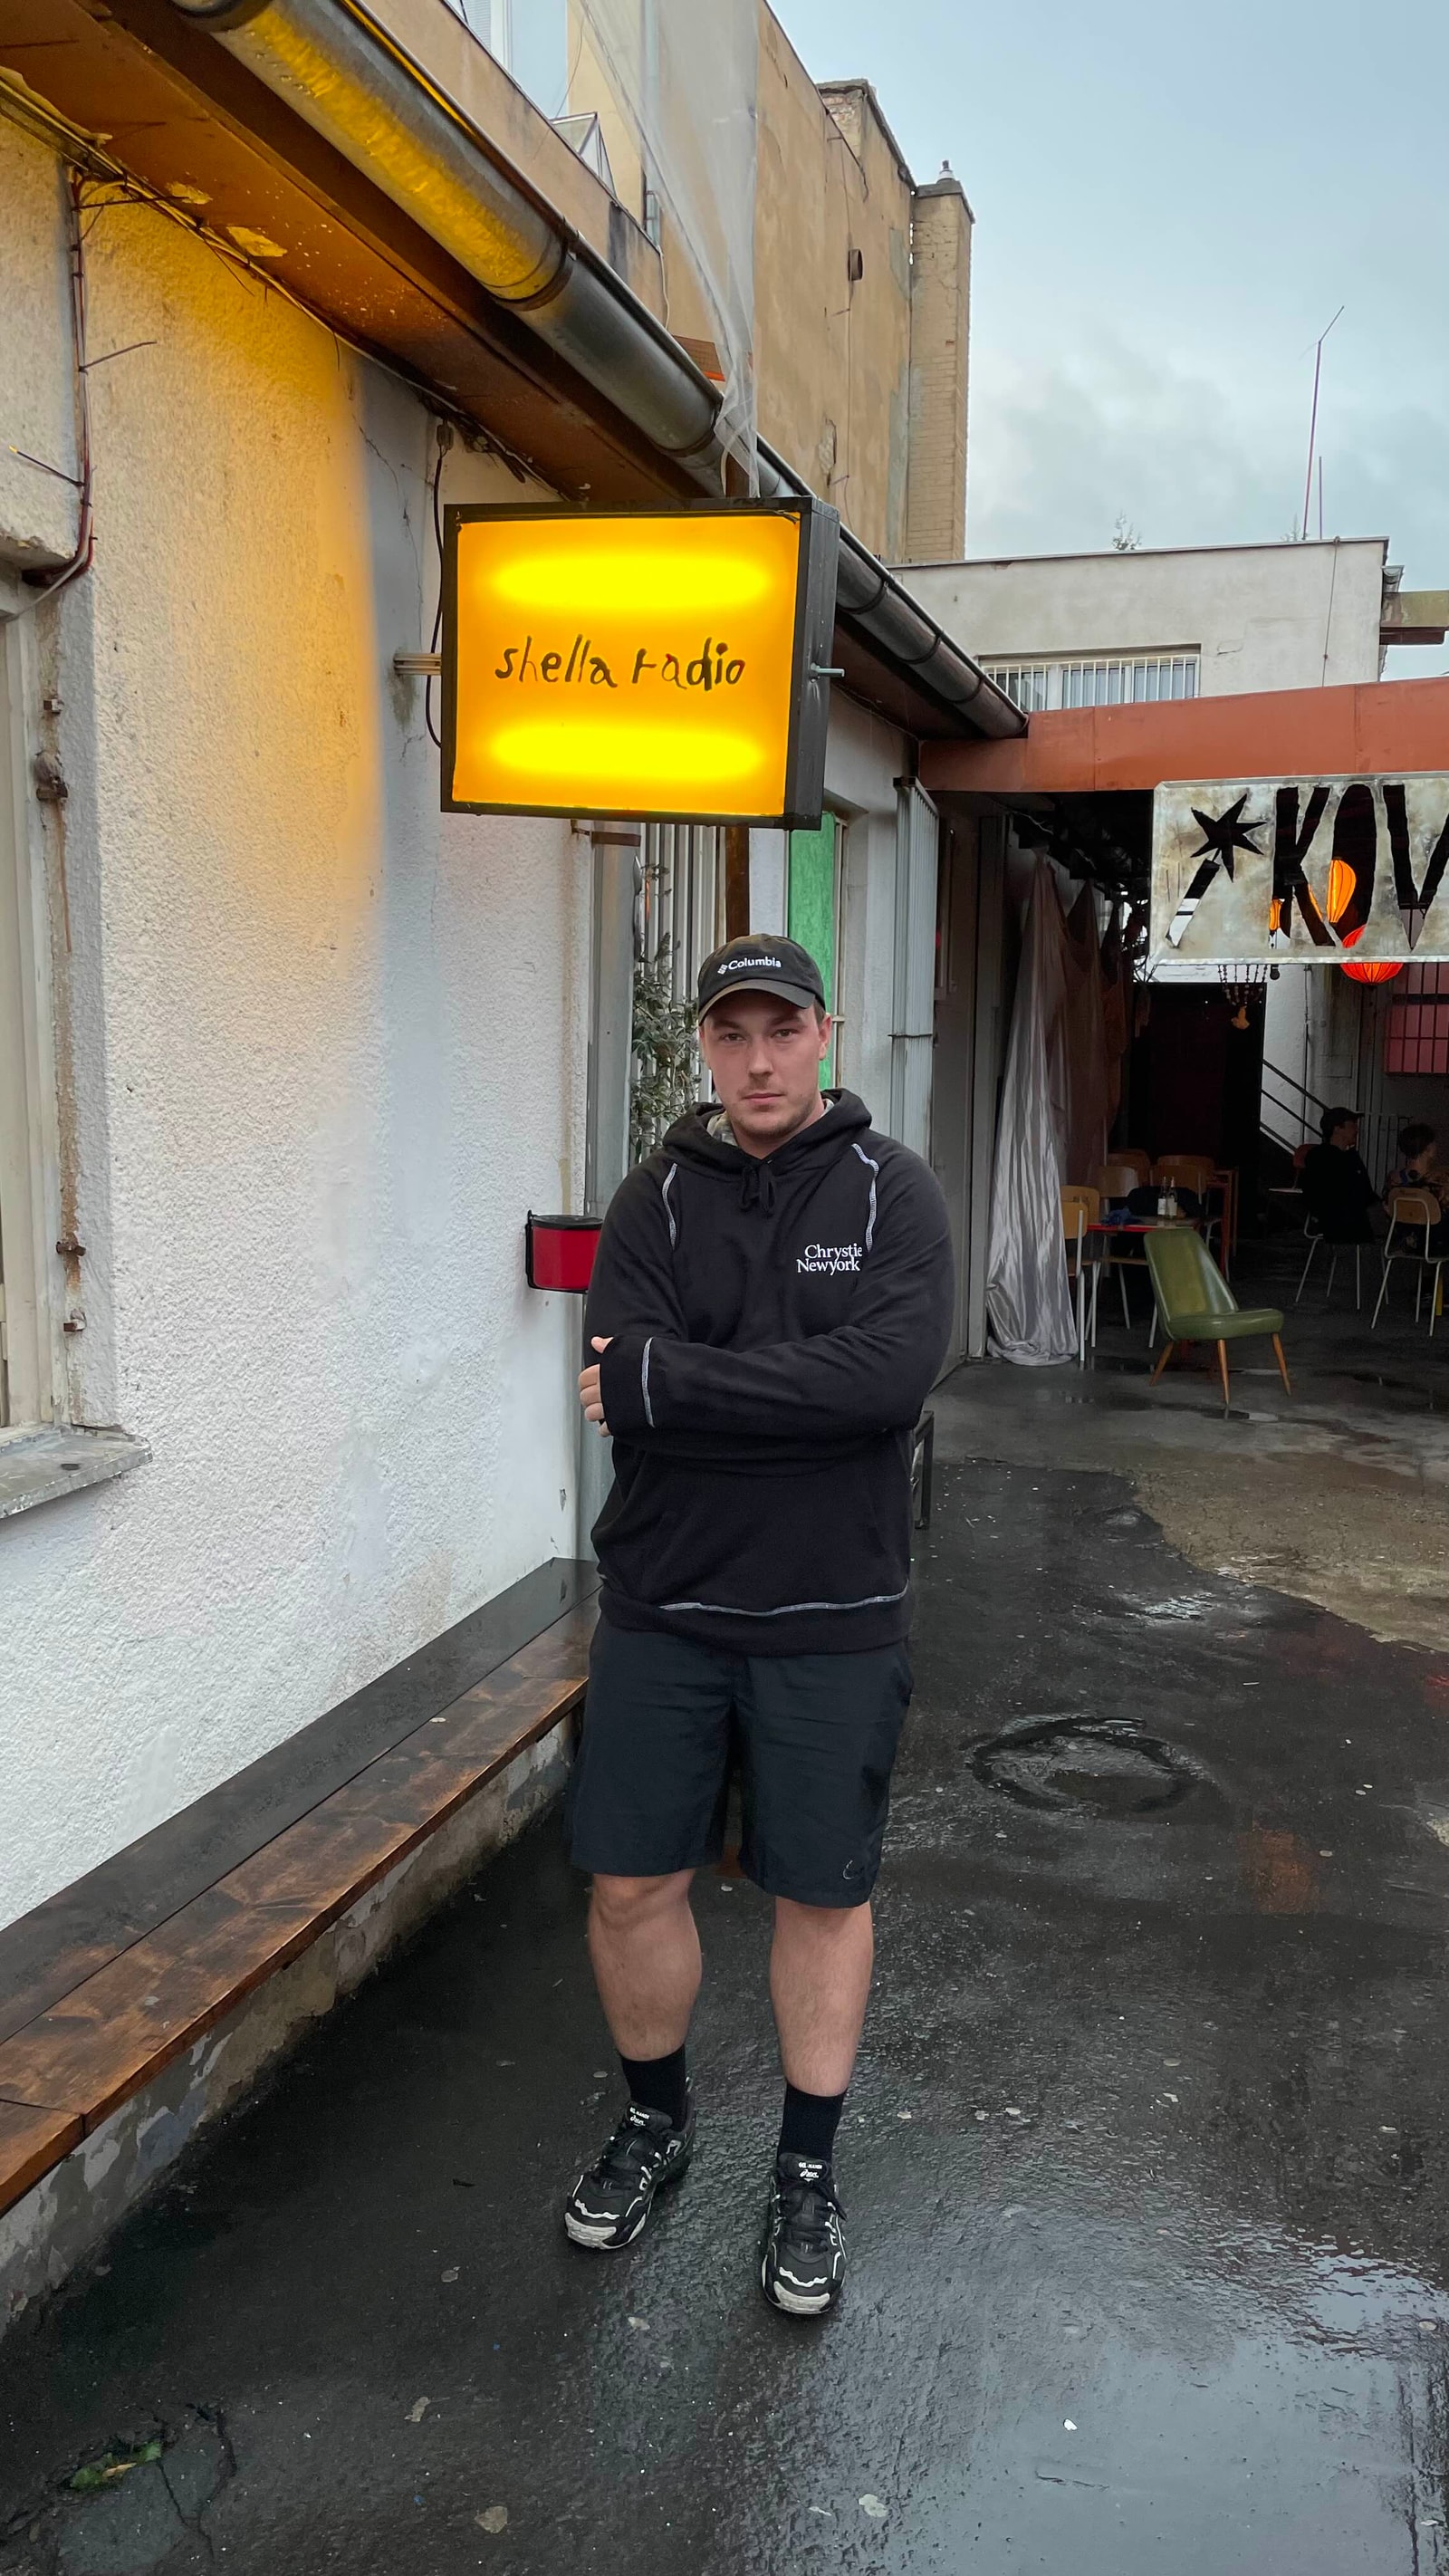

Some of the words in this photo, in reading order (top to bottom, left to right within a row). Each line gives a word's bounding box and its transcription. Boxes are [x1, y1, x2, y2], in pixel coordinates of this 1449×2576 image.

[494, 634, 619, 688] shella
[631, 637, 746, 692] radio
[728, 956, 782, 970] Columbia
[804, 1243, 863, 1260] Chrystie
[796, 1256, 861, 1276] Newyork
